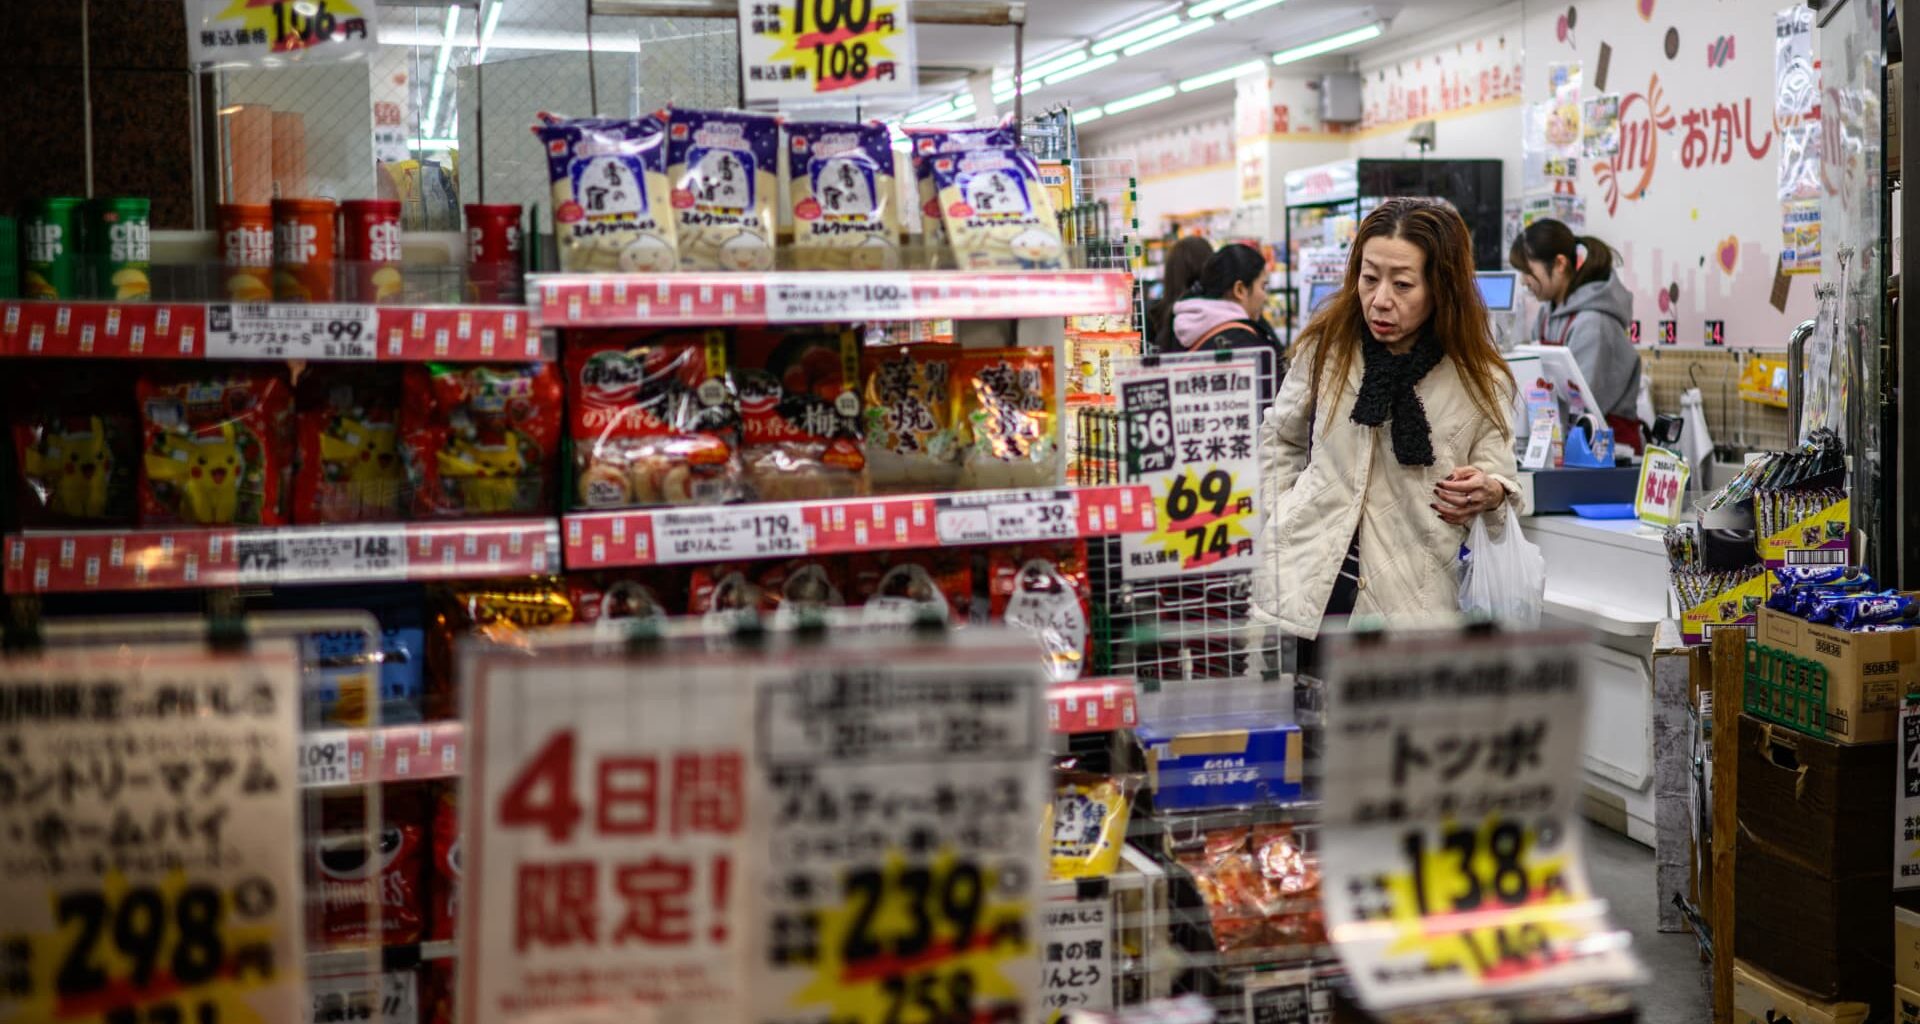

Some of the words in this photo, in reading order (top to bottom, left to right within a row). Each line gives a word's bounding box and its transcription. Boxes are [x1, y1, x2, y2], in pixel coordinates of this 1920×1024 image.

[1681, 97, 1772, 168] おかし
[328, 321, 363, 341] 99
[1666, 320, 1676, 343] 3
[1713, 321, 1722, 343] 4
[1180, 434, 1251, 464] 玄米茶
[754, 515, 788, 537] 179
[354, 537, 389, 558] 148
[1864, 662, 1898, 674] 50836
[1392, 716, 1547, 790] トッポ
[499, 726, 746, 843] 4日間
[514, 852, 733, 952] 限定!
